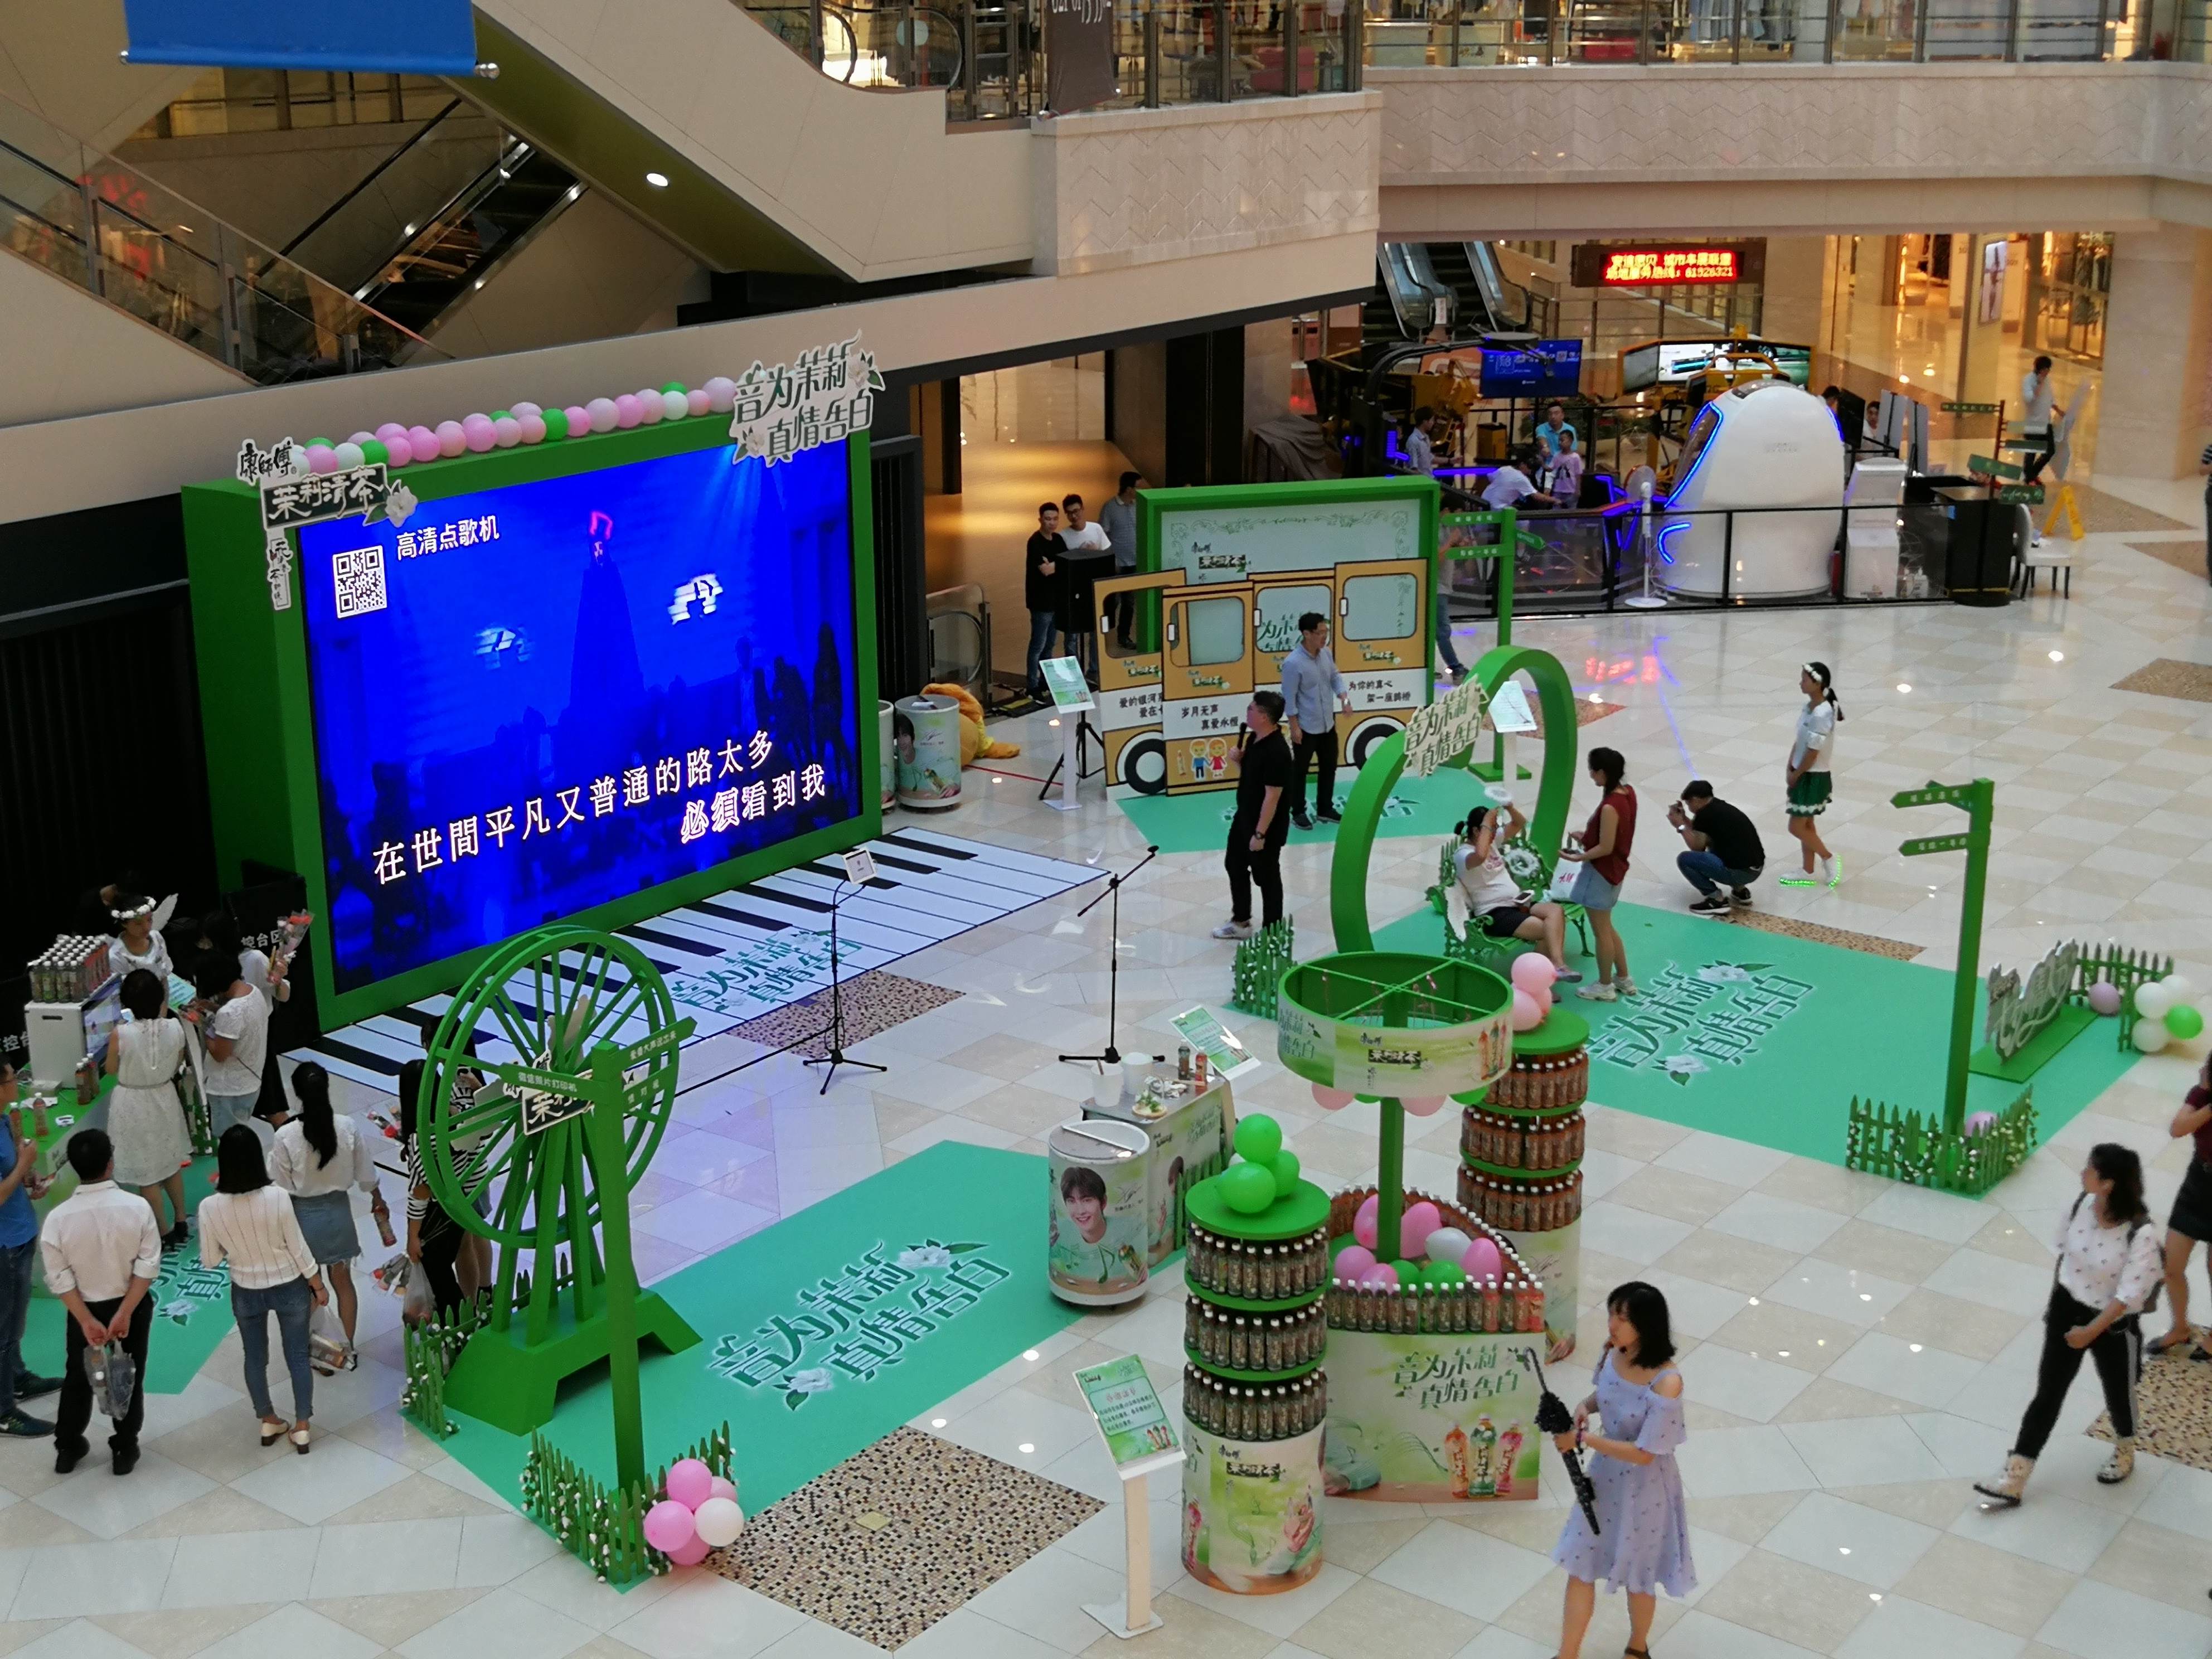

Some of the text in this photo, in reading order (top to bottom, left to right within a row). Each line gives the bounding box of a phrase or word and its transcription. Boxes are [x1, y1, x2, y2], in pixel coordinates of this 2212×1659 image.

[735, 335, 858, 424] 音为茉莉
[766, 389, 871, 465] 真情告白
[268, 468, 384, 518] 茉莉清茶
[396, 515, 499, 561] 高清点歌机
[1181, 704, 1219, 719] 岁月无声
[1348, 680, 1393, 691] 为你的真心
[1421, 712, 1481, 775] 真情告白
[373, 730, 772, 885] 在世間平凡又普通的路太多
[681, 763, 826, 844] 必須看到我
[741, 939, 864, 1003] 真情告白
[1682, 975, 1814, 1065] 真情告白
[709, 1240, 916, 1387] 音为茉莉
[819, 1258, 1010, 1381] 真情告白
[1394, 1343, 1497, 1384] 音为茉莉
[1420, 1369, 1519, 1409] 真情告白
